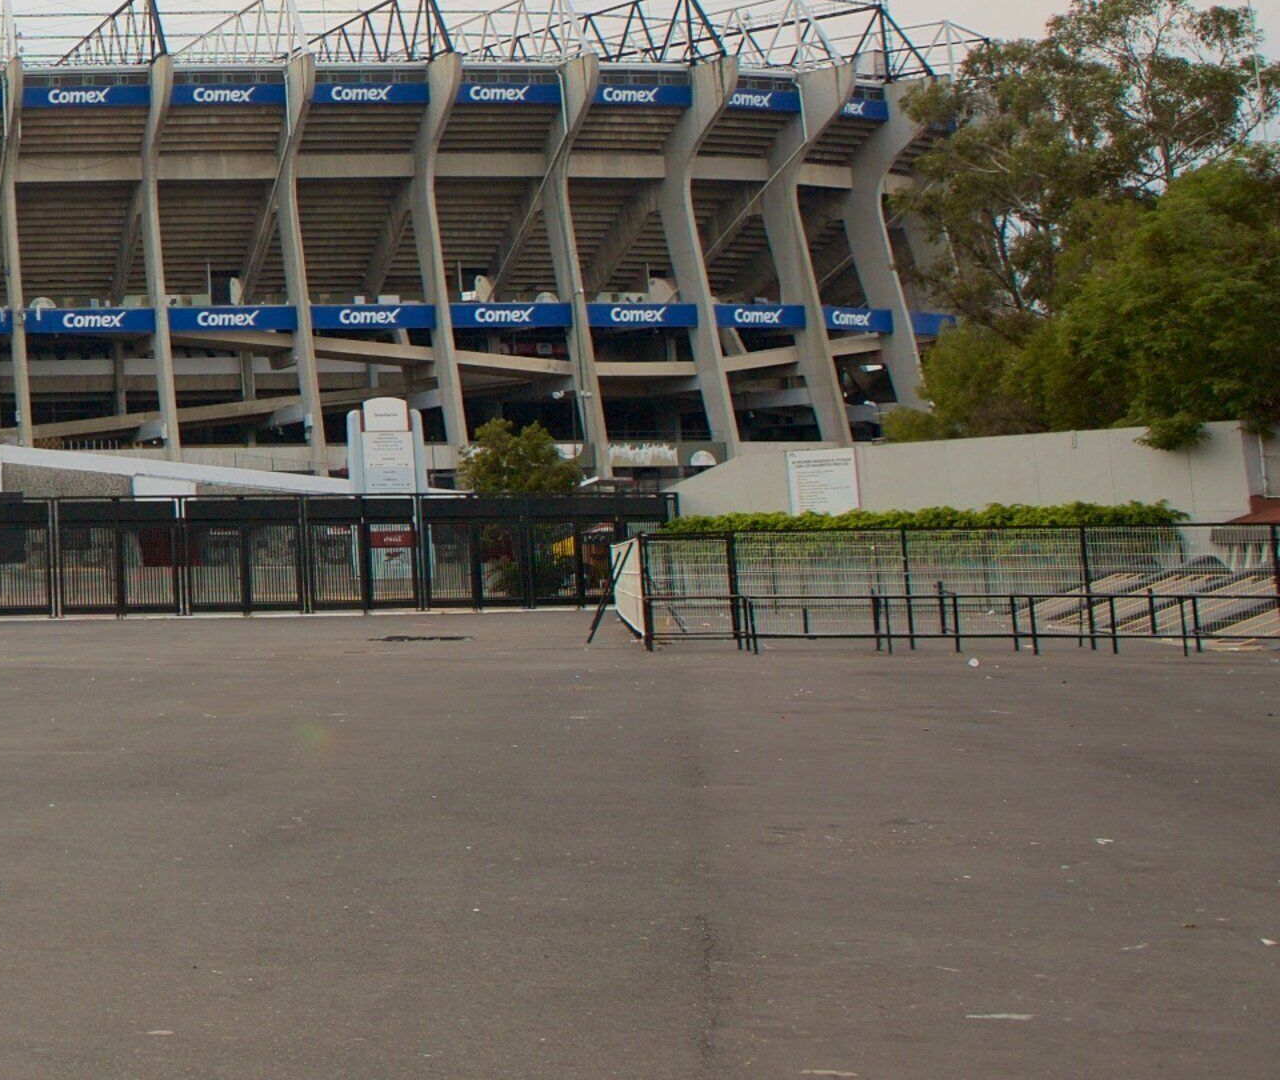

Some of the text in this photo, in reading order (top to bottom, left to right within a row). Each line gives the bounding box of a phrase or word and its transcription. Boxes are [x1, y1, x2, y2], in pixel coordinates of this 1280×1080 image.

[48, 87, 110, 104] Comex
[193, 87, 256, 103] Comex
[331, 85, 392, 101] Comex
[469, 85, 530, 101] Comex
[603, 87, 659, 102] Comex
[728, 92, 772, 107] omex
[63, 311, 126, 328] Comex
[197, 310, 260, 327] Comex
[339, 308, 401, 324] Comex
[475, 306, 535, 323] Comex
[610, 306, 667, 323] Comex
[734, 308, 783, 324] Comex
[832, 310, 871, 326] Comex
